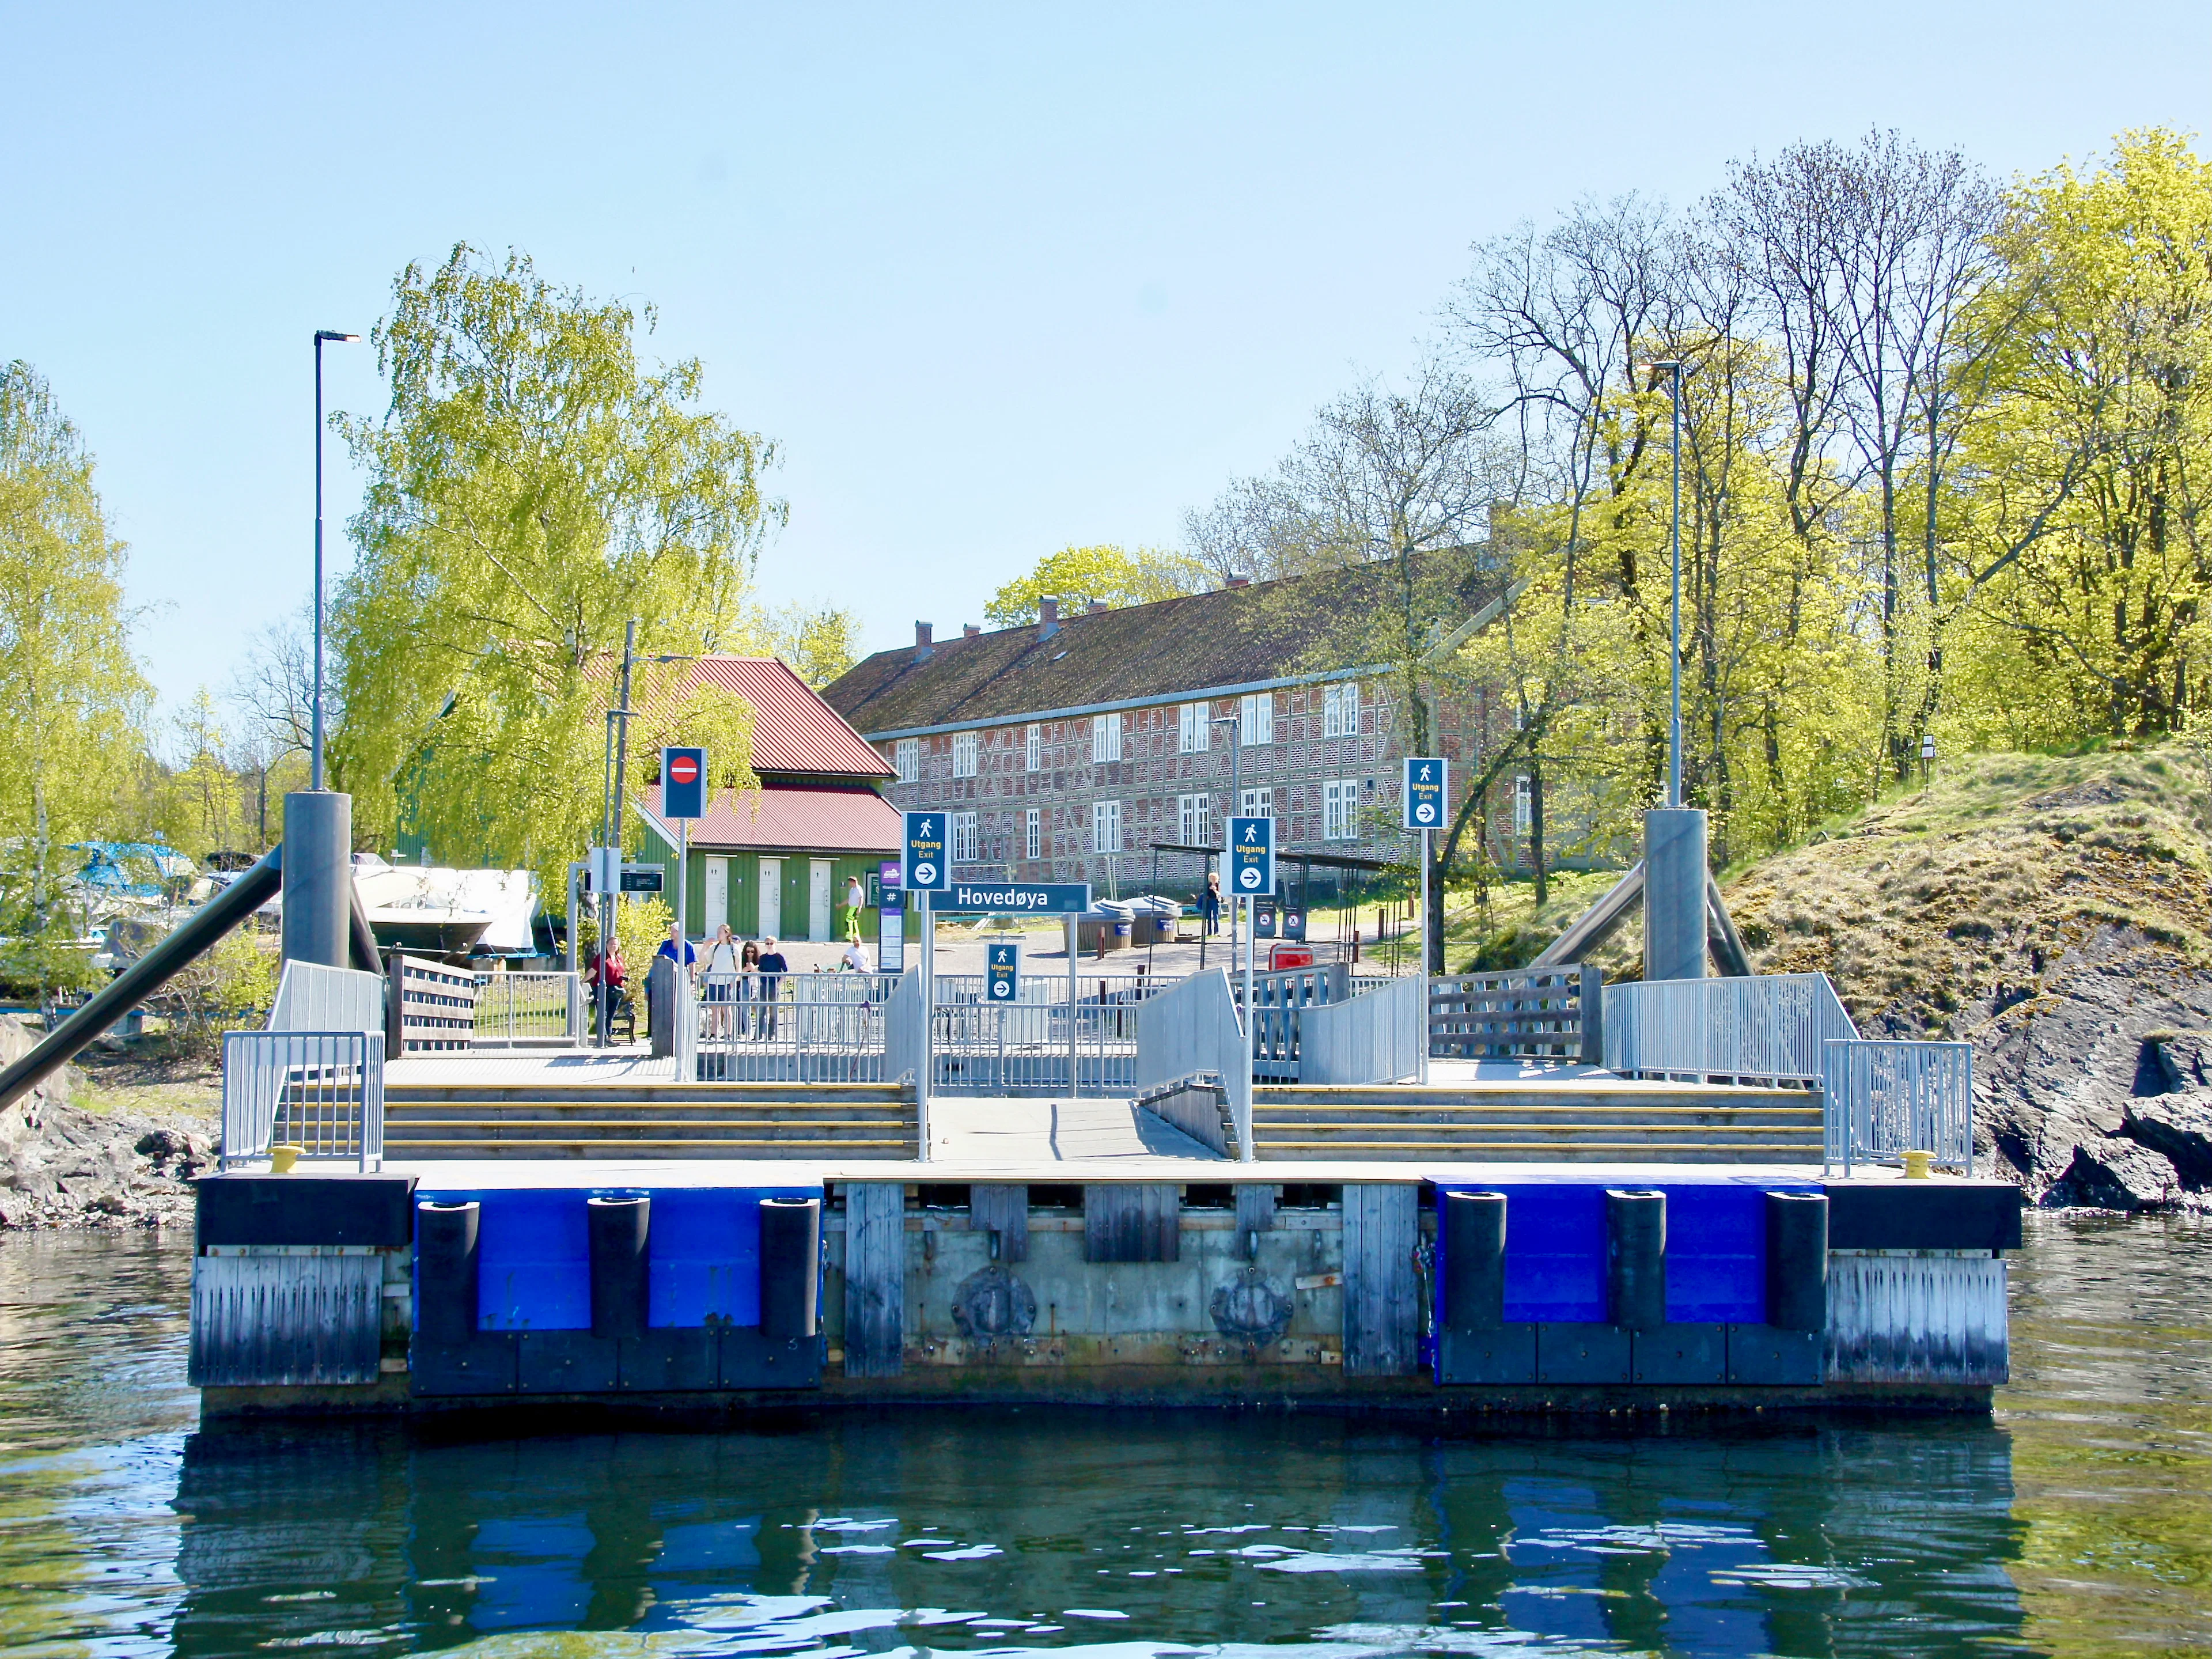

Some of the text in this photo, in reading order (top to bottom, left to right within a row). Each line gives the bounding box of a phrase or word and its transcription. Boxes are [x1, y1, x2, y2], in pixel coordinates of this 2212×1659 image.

[1412, 783, 1439, 792] Utgang
[911, 840, 941, 850] Utgang
[1236, 845, 1266, 854] Utgang
[959, 888, 1048, 910] Hovedøya
